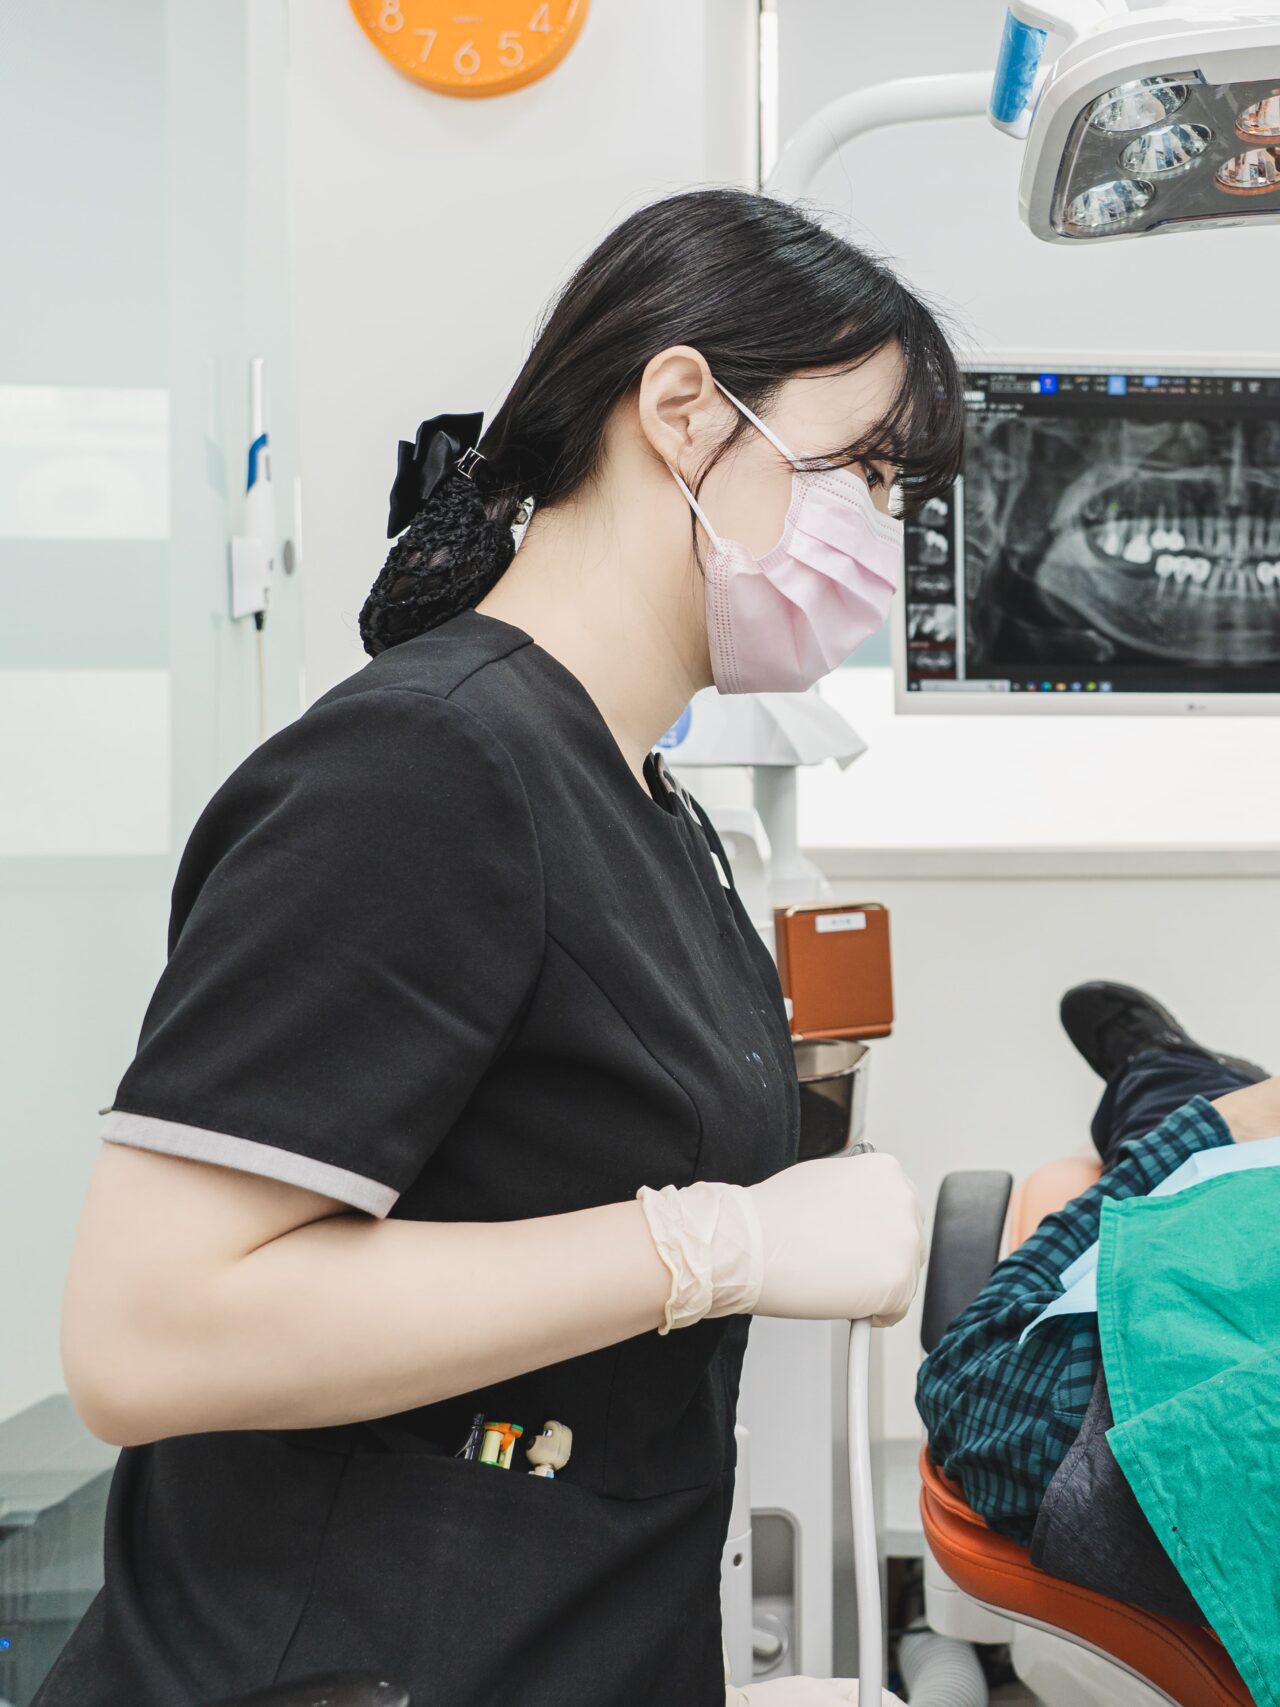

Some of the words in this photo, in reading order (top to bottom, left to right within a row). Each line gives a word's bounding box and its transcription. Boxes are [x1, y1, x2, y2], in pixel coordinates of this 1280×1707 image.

[379, 0, 404, 33] 8
[528, 3, 551, 33] 4
[415, 29, 438, 63] 7
[454, 41, 480, 76] 6
[498, 32, 524, 67] 5
